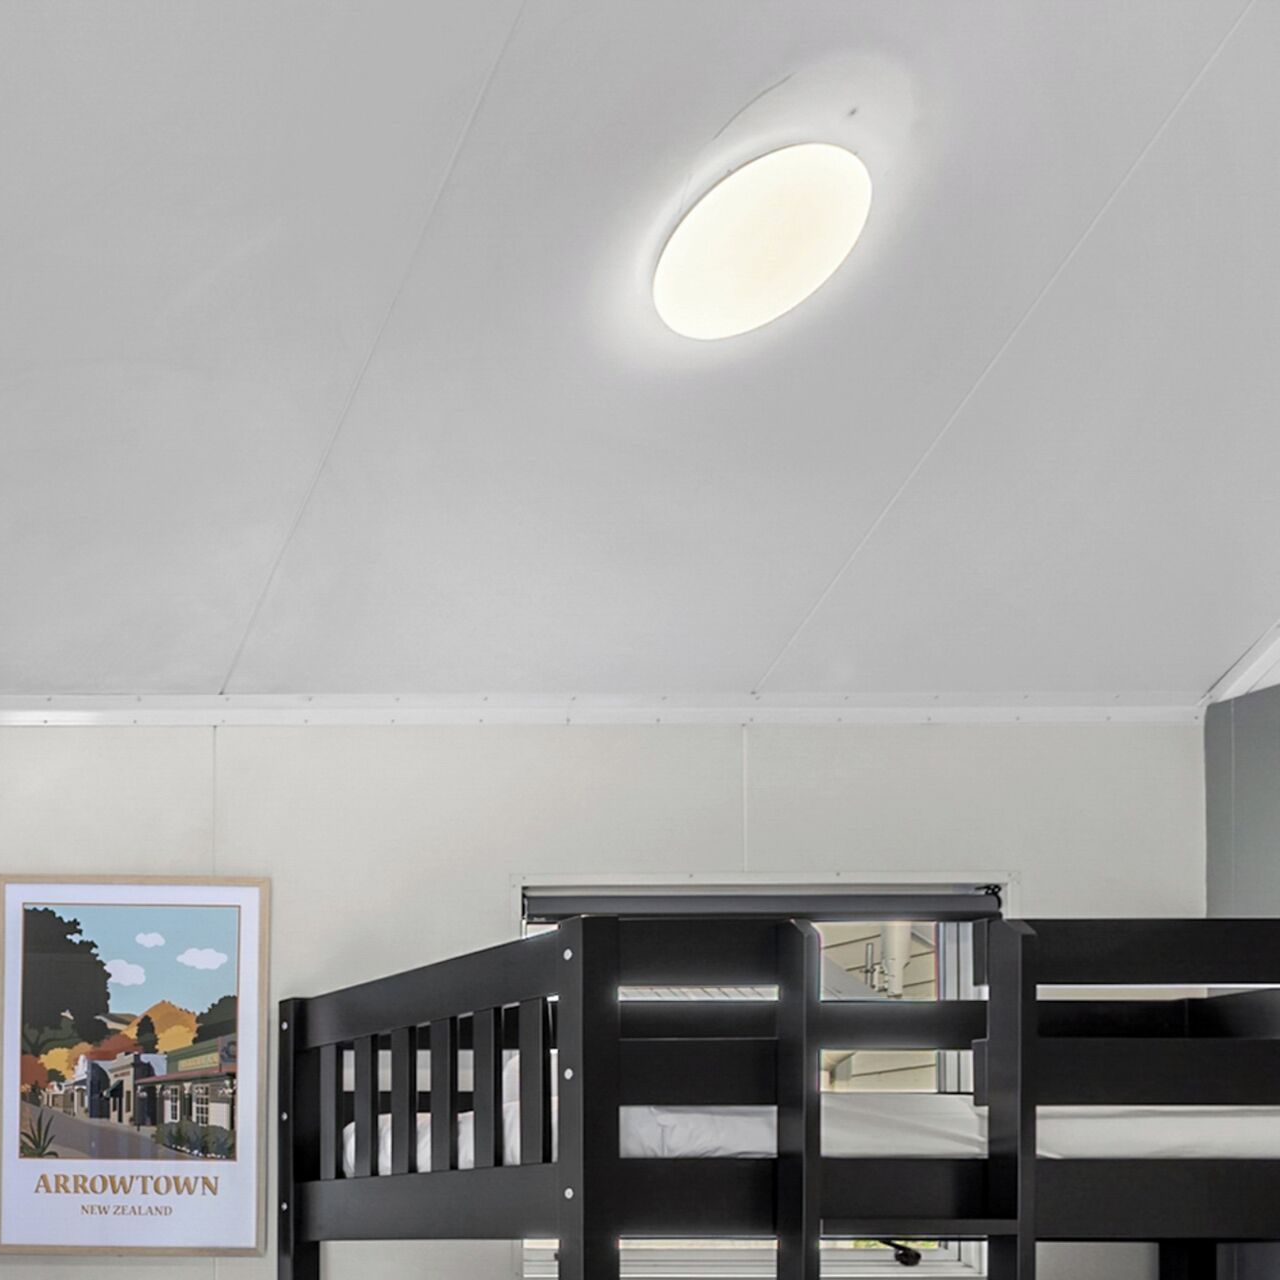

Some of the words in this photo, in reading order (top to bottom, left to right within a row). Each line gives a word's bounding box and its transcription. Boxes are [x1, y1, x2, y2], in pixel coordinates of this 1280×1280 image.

[34, 1173, 219, 1196] ARROWTOWN
[81, 1204, 111, 1216] NEW
[112, 1204, 173, 1217] ZEALAND
